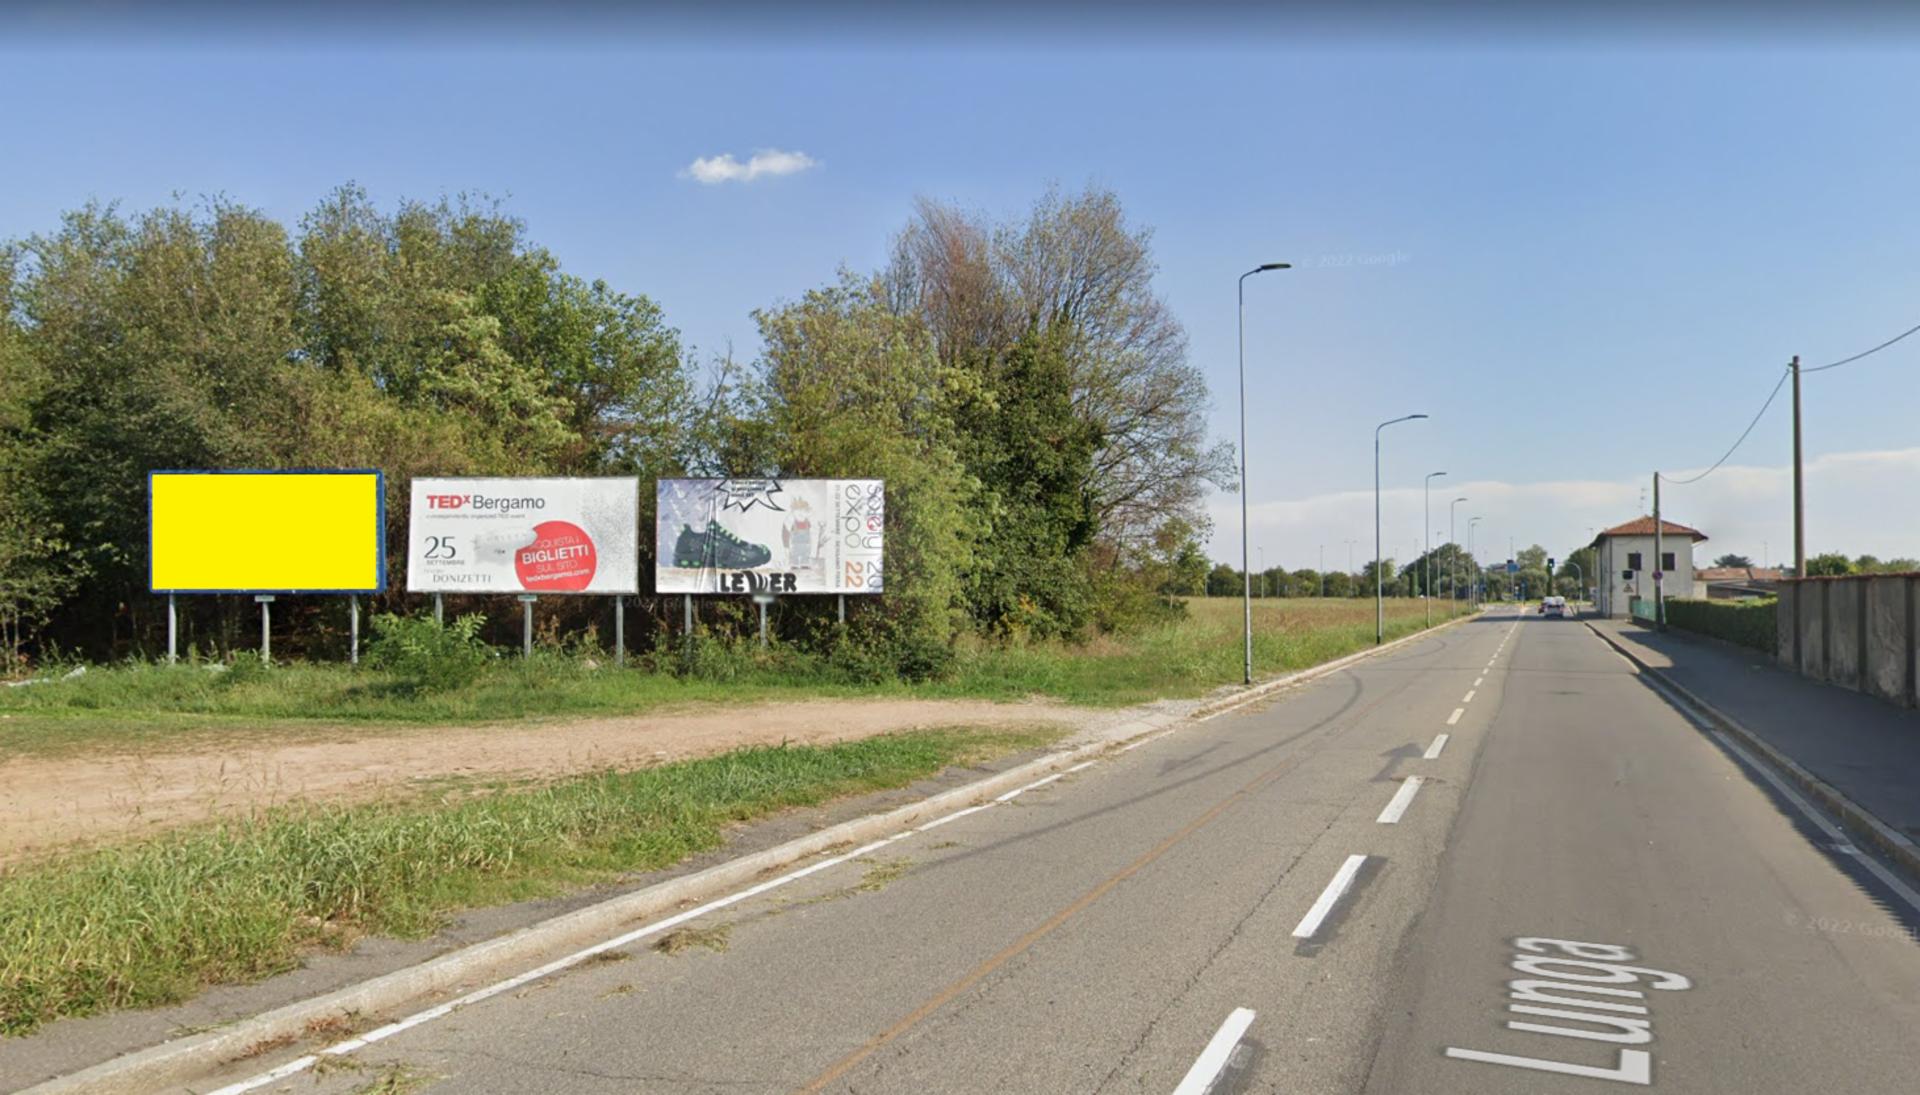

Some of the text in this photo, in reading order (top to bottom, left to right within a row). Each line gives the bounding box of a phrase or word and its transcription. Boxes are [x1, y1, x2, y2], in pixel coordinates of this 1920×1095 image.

[840, 484, 864, 588] expo 22
[424, 536, 456, 559] 25
[522, 544, 589, 565] BIGLIETTI
[433, 574, 491, 583] DONIZETTI
